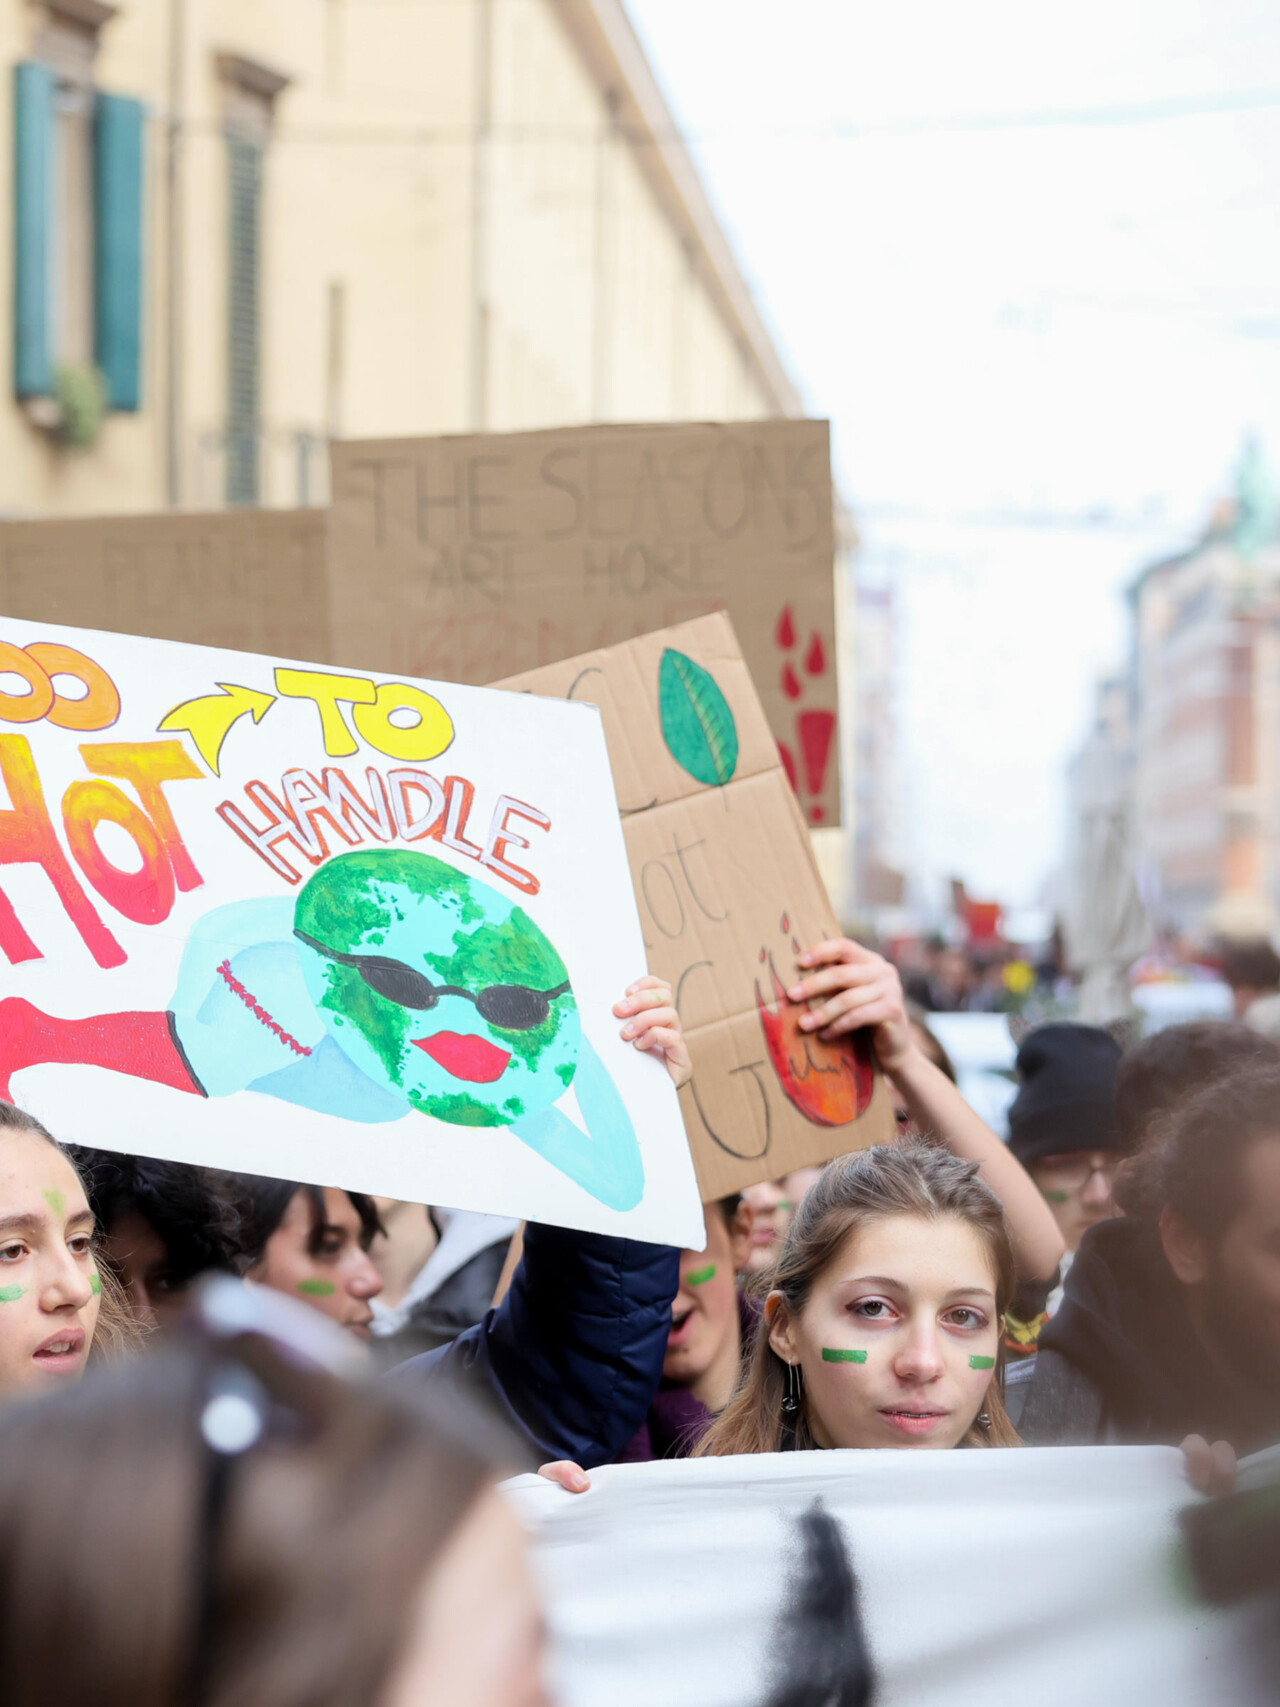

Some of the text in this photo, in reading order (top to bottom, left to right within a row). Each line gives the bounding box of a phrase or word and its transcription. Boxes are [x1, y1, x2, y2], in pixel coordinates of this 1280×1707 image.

[347, 456, 518, 547] THE
[273, 667, 455, 761] TO
[215, 766, 552, 896] HANDLE
